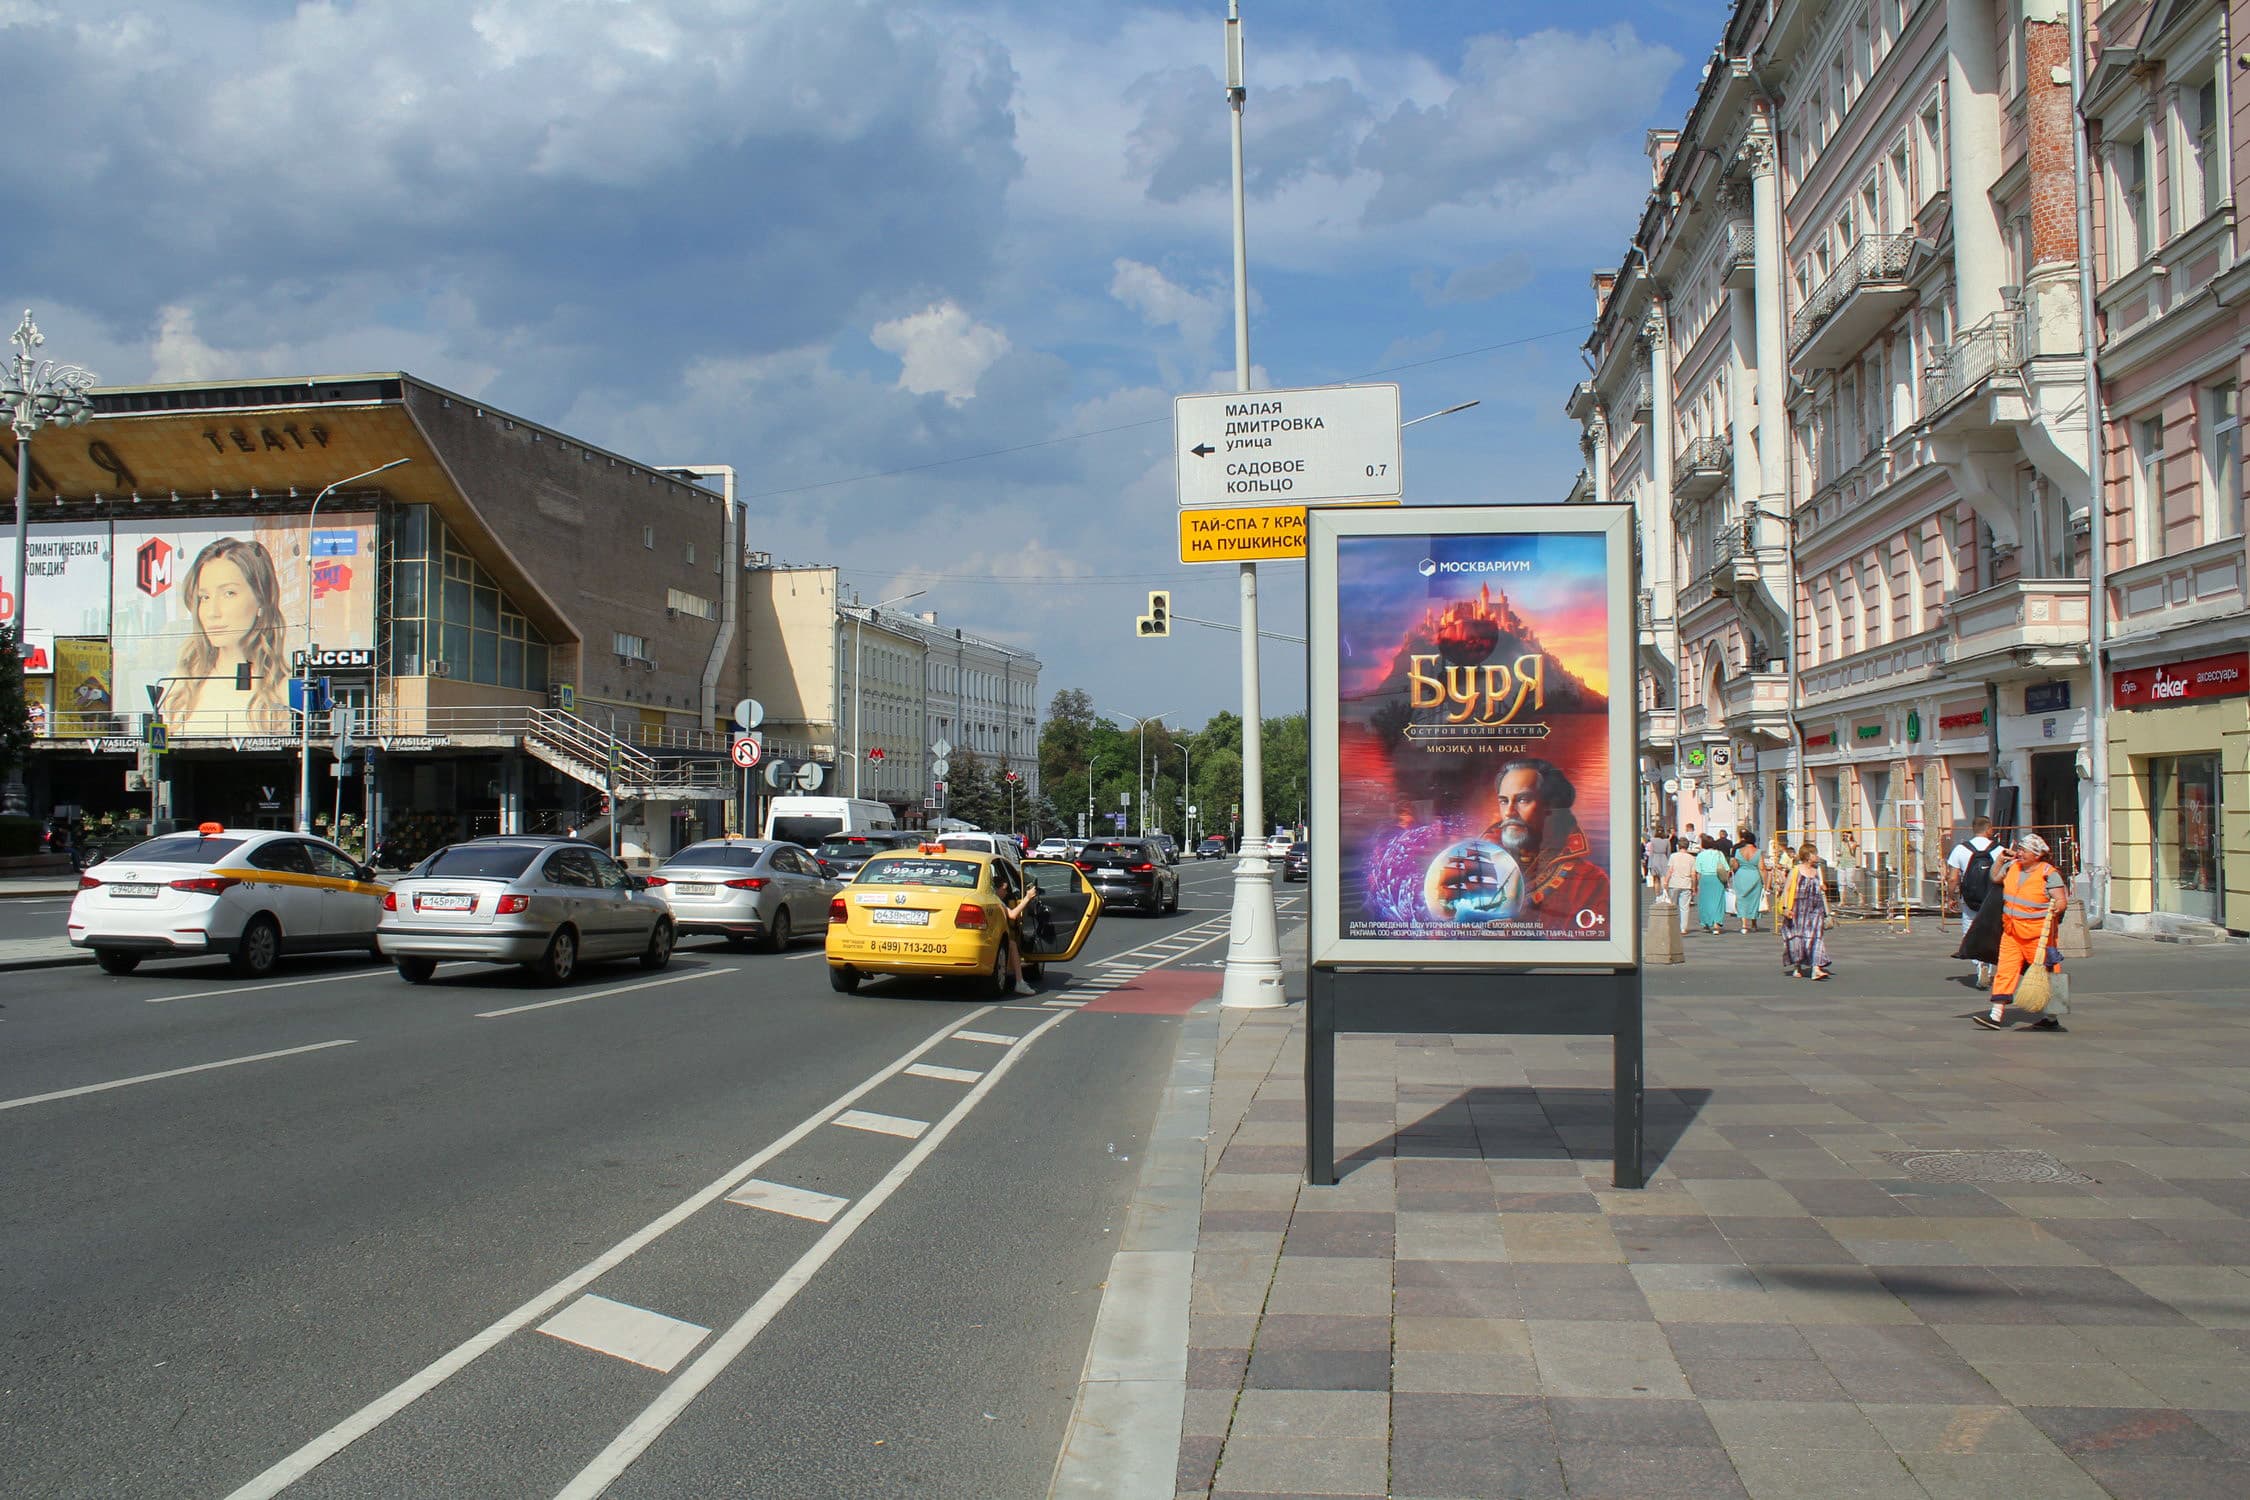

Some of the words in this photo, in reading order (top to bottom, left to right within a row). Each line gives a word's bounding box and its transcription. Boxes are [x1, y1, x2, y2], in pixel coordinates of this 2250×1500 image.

[1225, 401, 1282, 417] МАЛАЯ
[1225, 417, 1324, 436] ДМИТРОВКА
[202, 424, 329, 454] ТЕАТР
[1226, 437, 1272, 452] улица
[1226, 460, 1305, 476] САДОВОЕ
[1366, 464, 1387, 477] 0.7
[1227, 478, 1293, 494] КОЛЬЦО
[1191, 517, 1257, 532] ТАЙ-СПА
[1262, 517, 1270, 530] 7
[1191, 540, 1213, 551] НА
[1439, 560, 1530, 573] МОСКВАРИУМ
[2196, 668, 2239, 683] аксессуары
[2151, 673, 2188, 700] rieker
[1410, 727, 1457, 736] ОСТРОВ
[1463, 727, 1543, 736] ВОЛШЕБСТВА
[245, 737, 300, 746] VASILCHUKI
[395, 737, 451, 746] VASILCHUKI
[1479, 744, 1493, 753] НА
[1499, 744, 1527, 753] ВОДЕ
[870, 941, 876, 950] 8
[878, 941, 901, 953] (499)
[903, 942, 947, 954] 713-20-03
